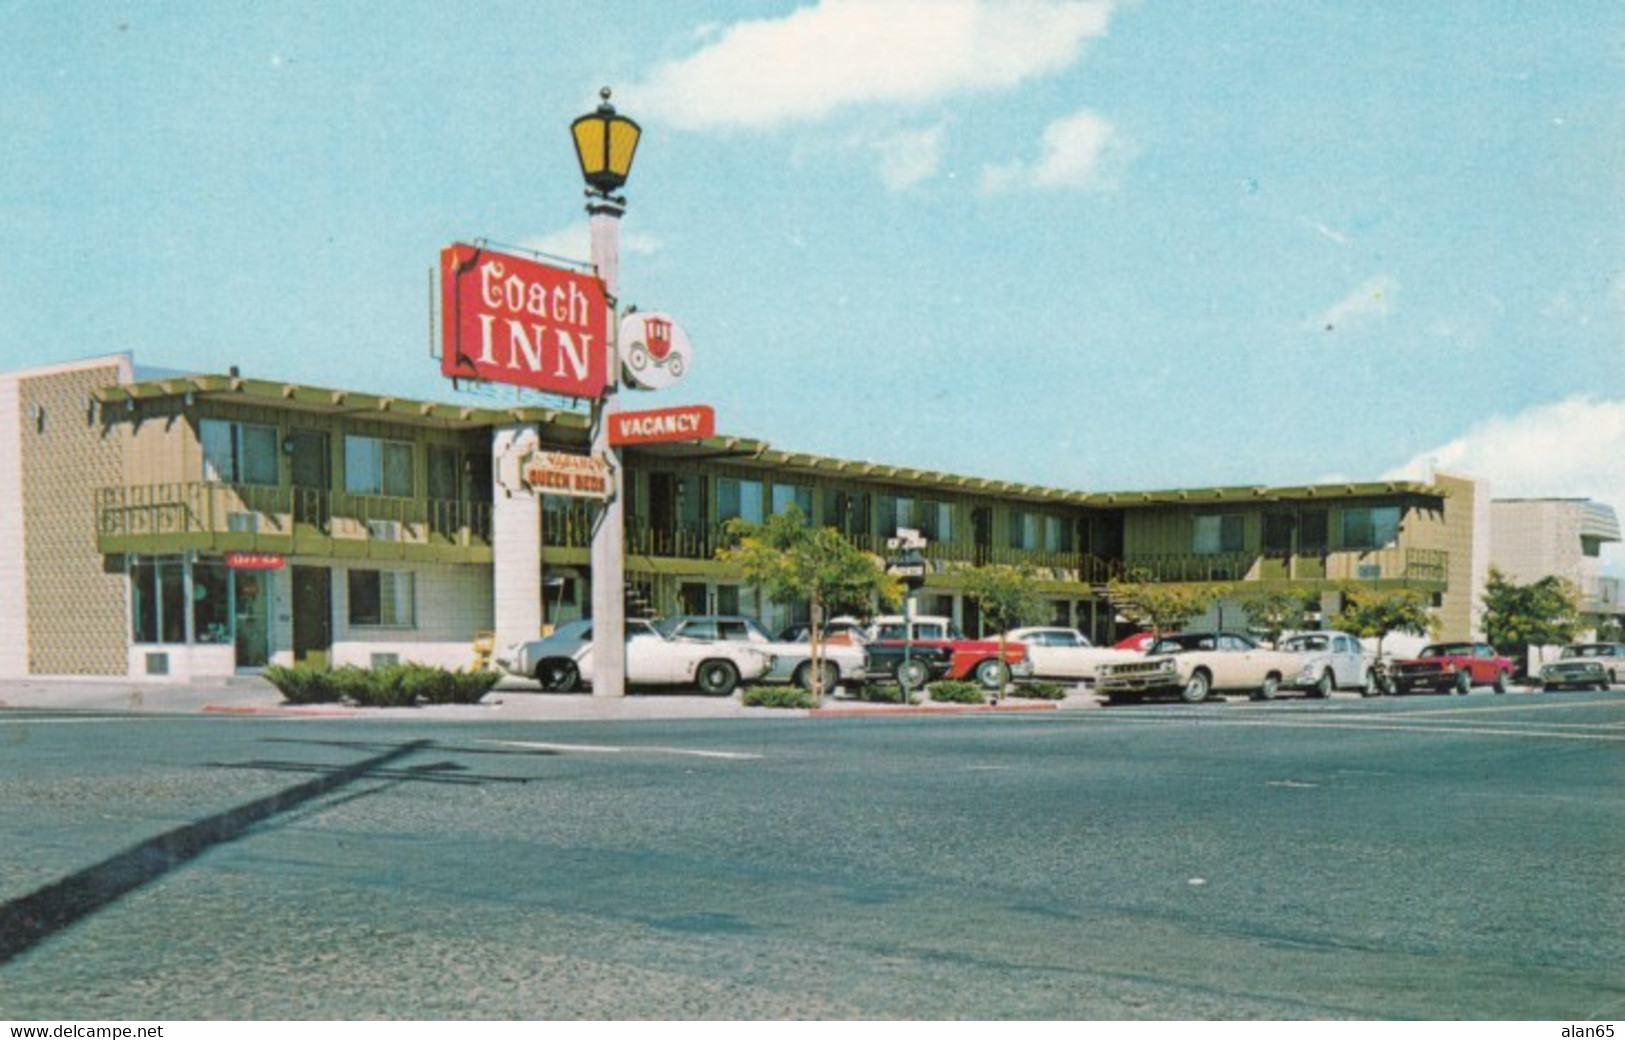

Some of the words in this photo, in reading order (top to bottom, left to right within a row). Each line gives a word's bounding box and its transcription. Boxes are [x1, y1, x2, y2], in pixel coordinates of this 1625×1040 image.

[480, 260, 589, 327] Coach
[477, 313, 593, 382] INN
[619, 412, 701, 437] VACANCY
[528, 469, 570, 489] QUEEN
